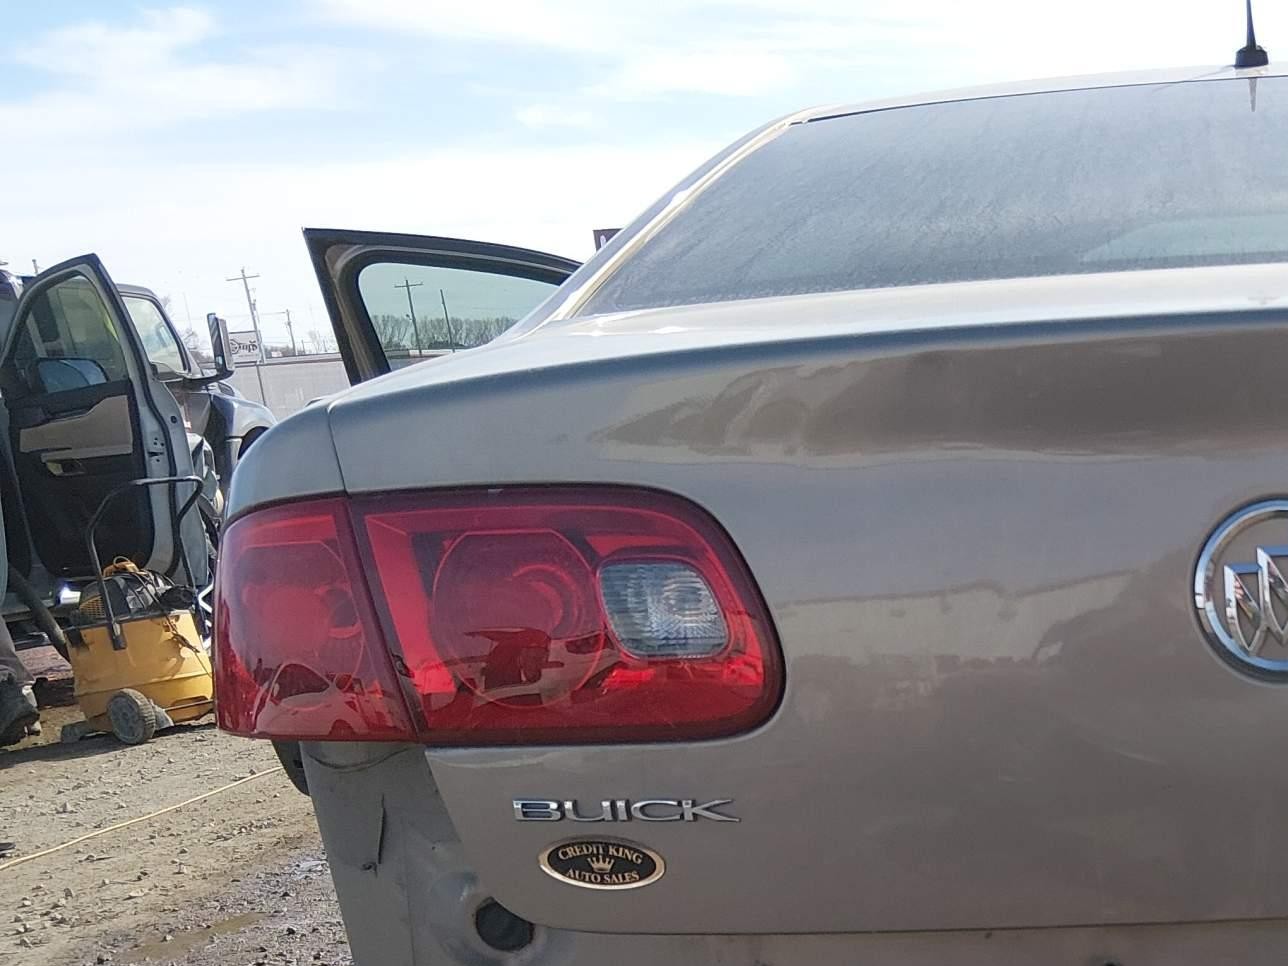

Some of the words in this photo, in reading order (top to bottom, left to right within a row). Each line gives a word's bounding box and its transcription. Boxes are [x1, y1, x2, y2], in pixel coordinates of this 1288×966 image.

[512, 799, 742, 823] BUICK
[558, 843, 605, 860] CREDIT
[608, 845, 643, 865] KING
[566, 868, 601, 883] AUTO
[603, 870, 640, 884] SALES
